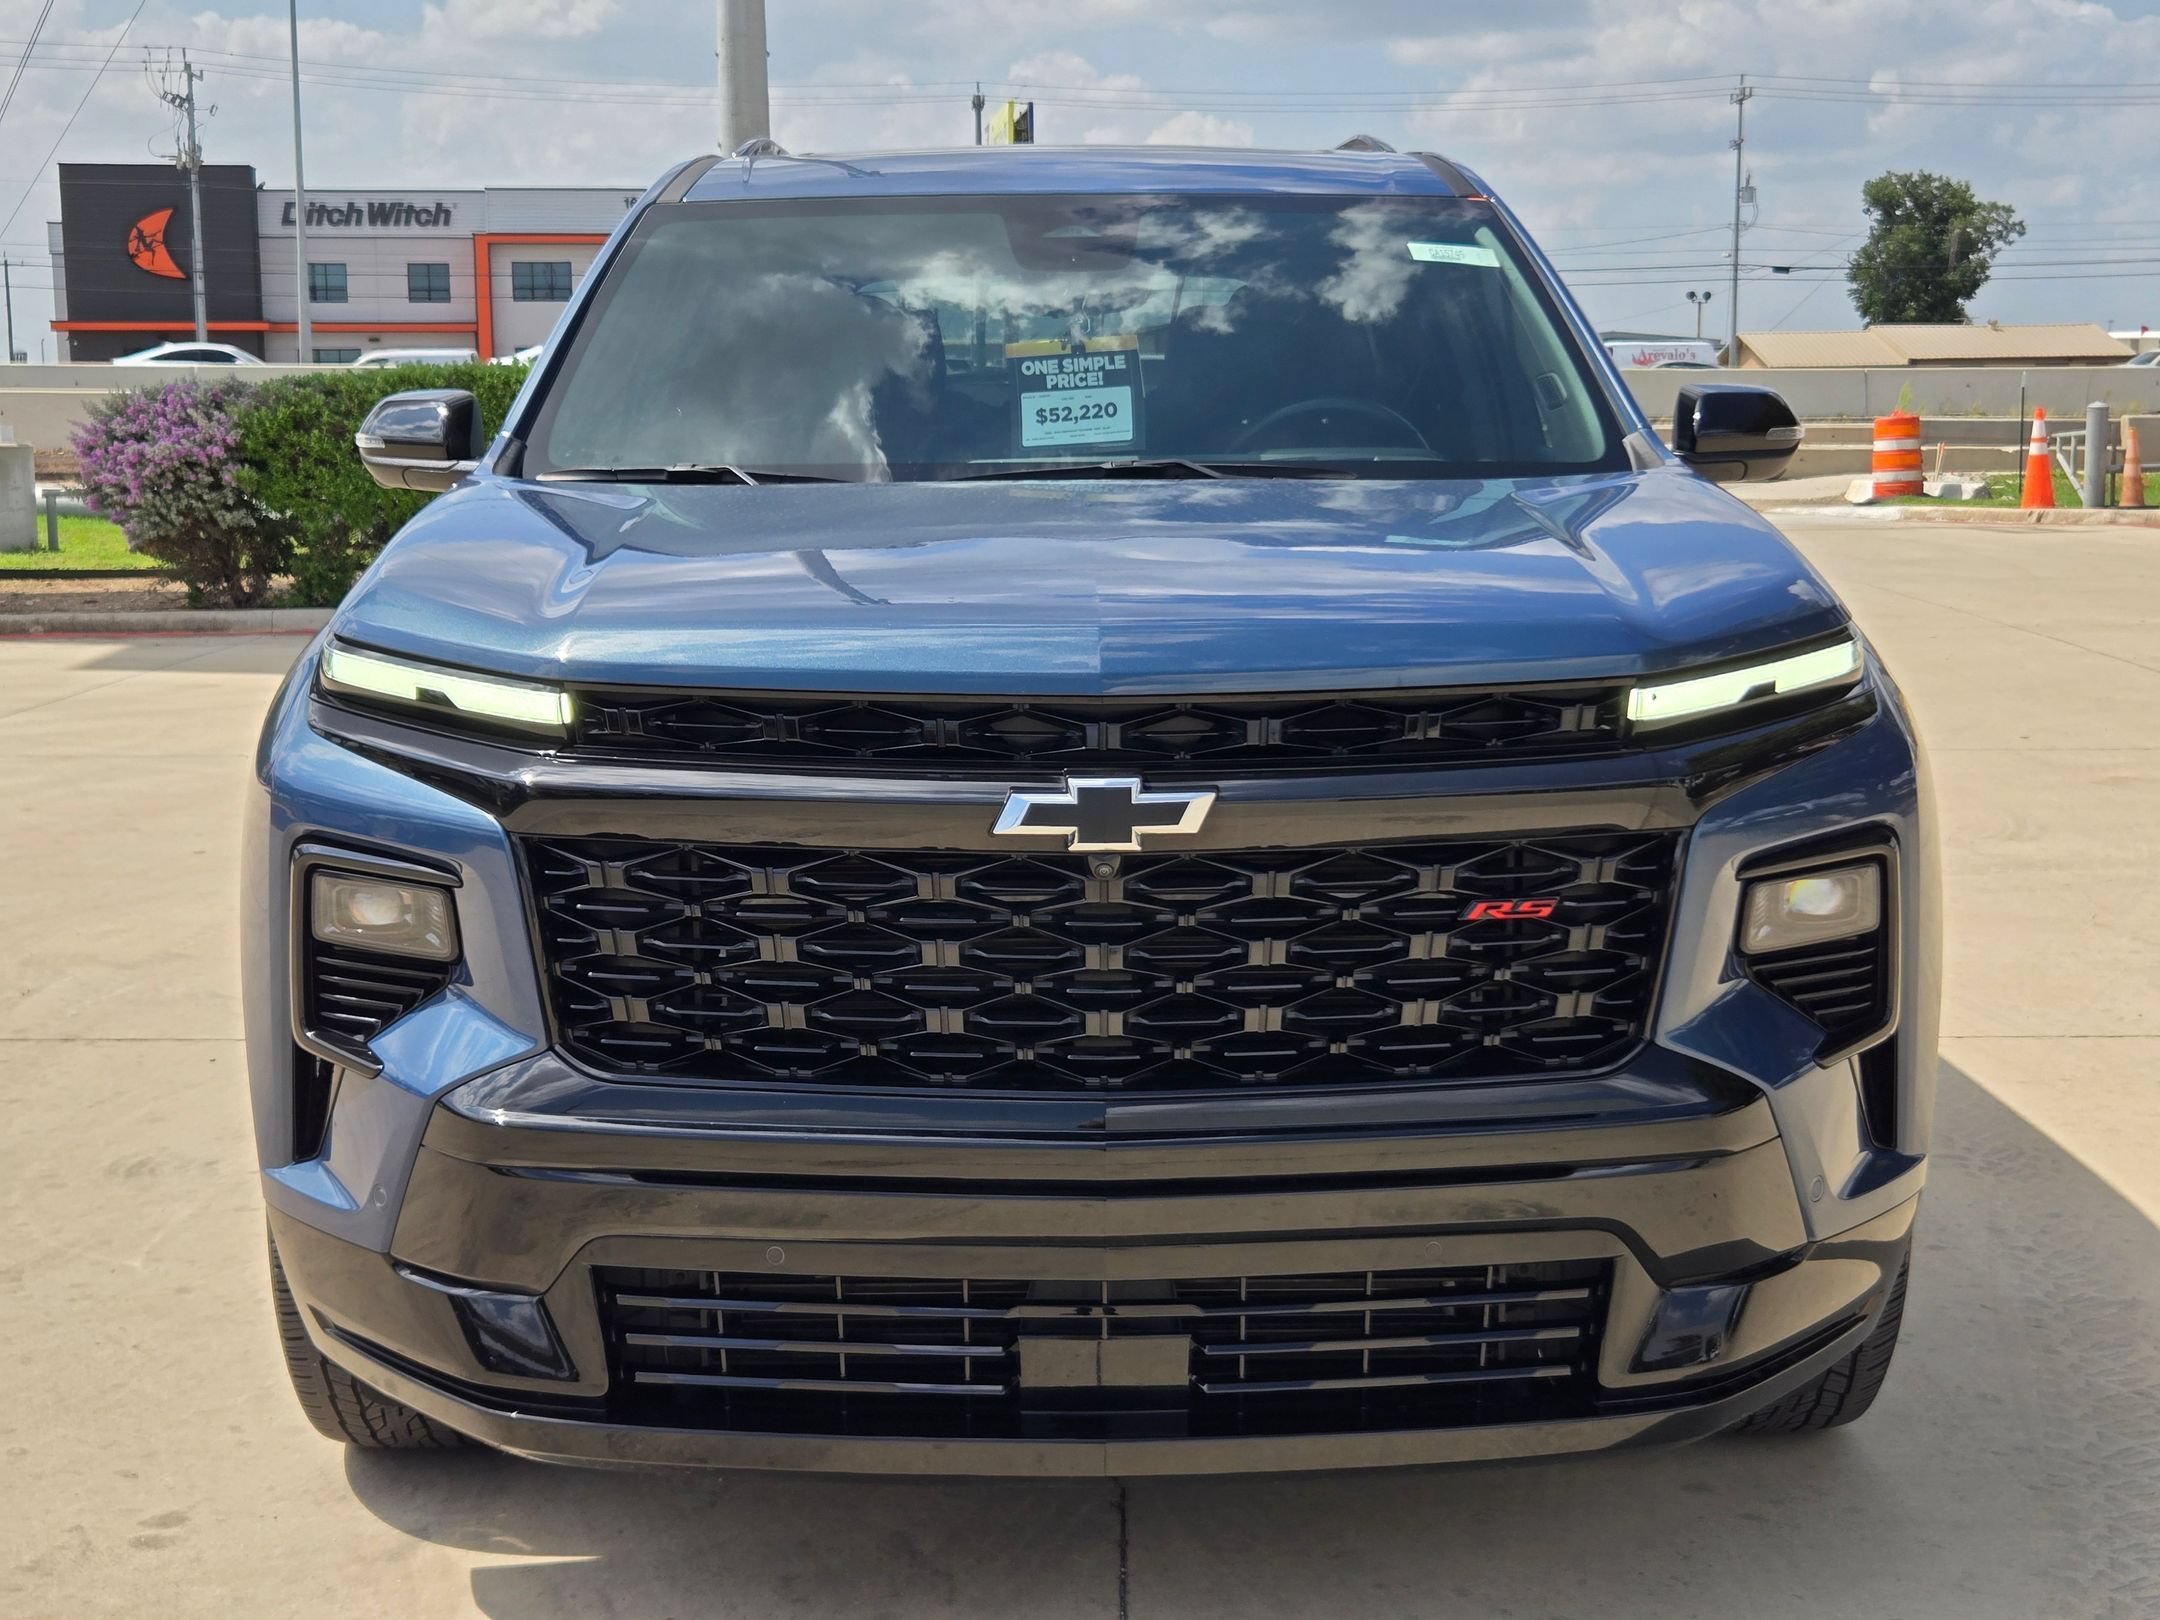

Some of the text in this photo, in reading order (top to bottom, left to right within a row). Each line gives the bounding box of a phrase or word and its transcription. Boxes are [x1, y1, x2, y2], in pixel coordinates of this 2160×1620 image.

[367, 202, 452, 227] Witch
[1021, 354, 1126, 376] ONE SIMPLE
[1638, 347, 1697, 362] Arevalo's
[1046, 371, 1104, 389] PRICE!
[1035, 402, 1118, 426] $52,220
[1462, 898, 1559, 920] RS
